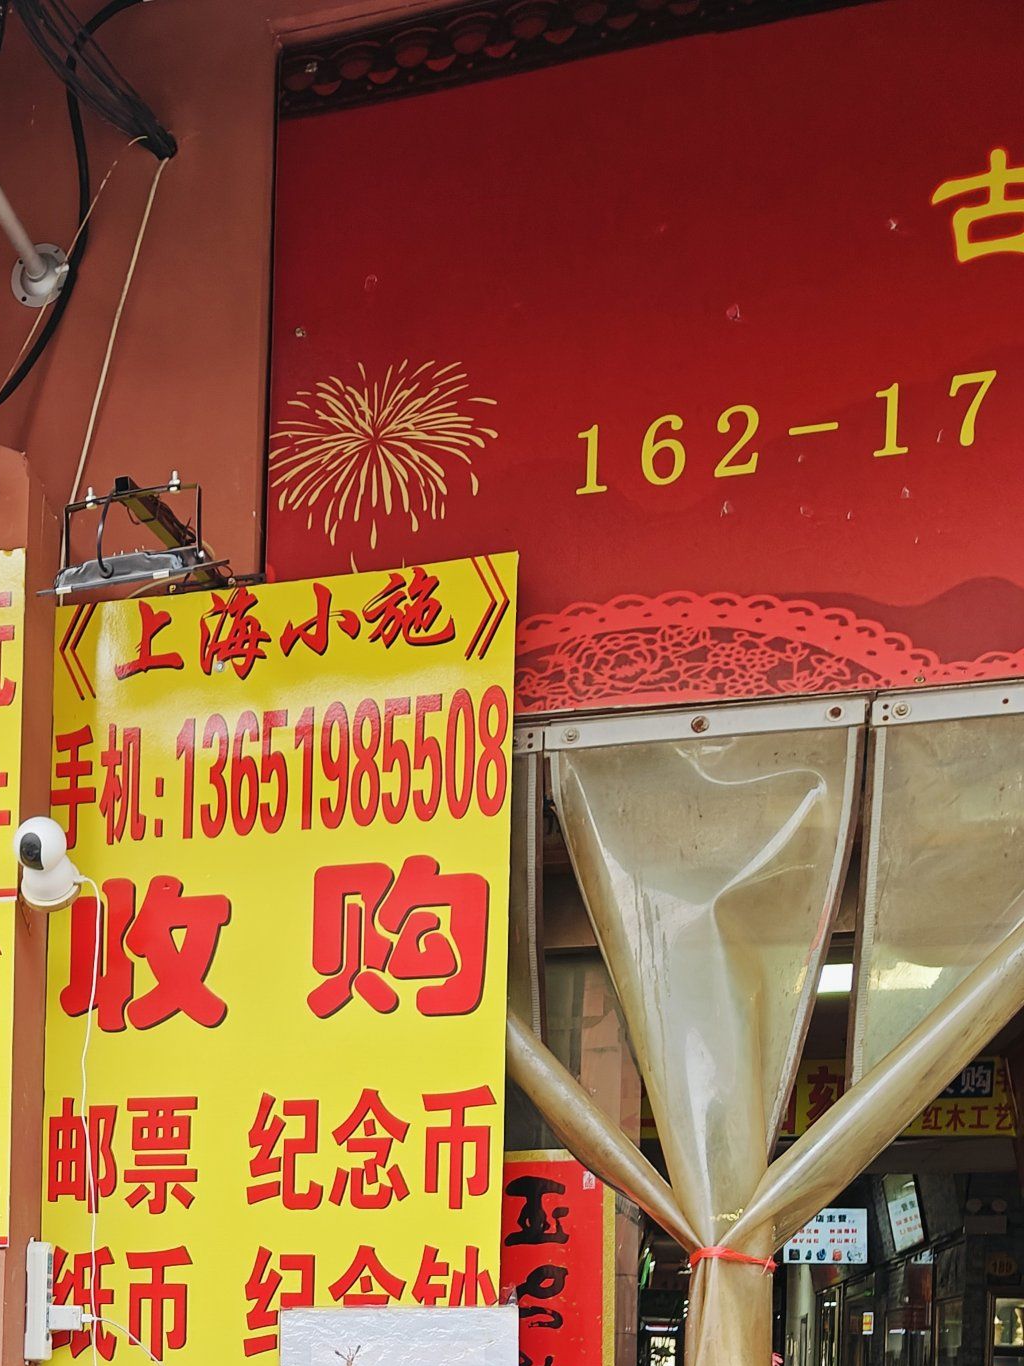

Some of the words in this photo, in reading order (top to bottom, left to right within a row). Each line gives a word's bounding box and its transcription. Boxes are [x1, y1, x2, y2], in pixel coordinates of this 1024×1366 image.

[59, 854, 490, 1033] 收购
[46, 1095, 200, 1215] 邮票
[246, 1085, 498, 1213] 纪念币
[50, 1245, 191, 1363] 纸币
